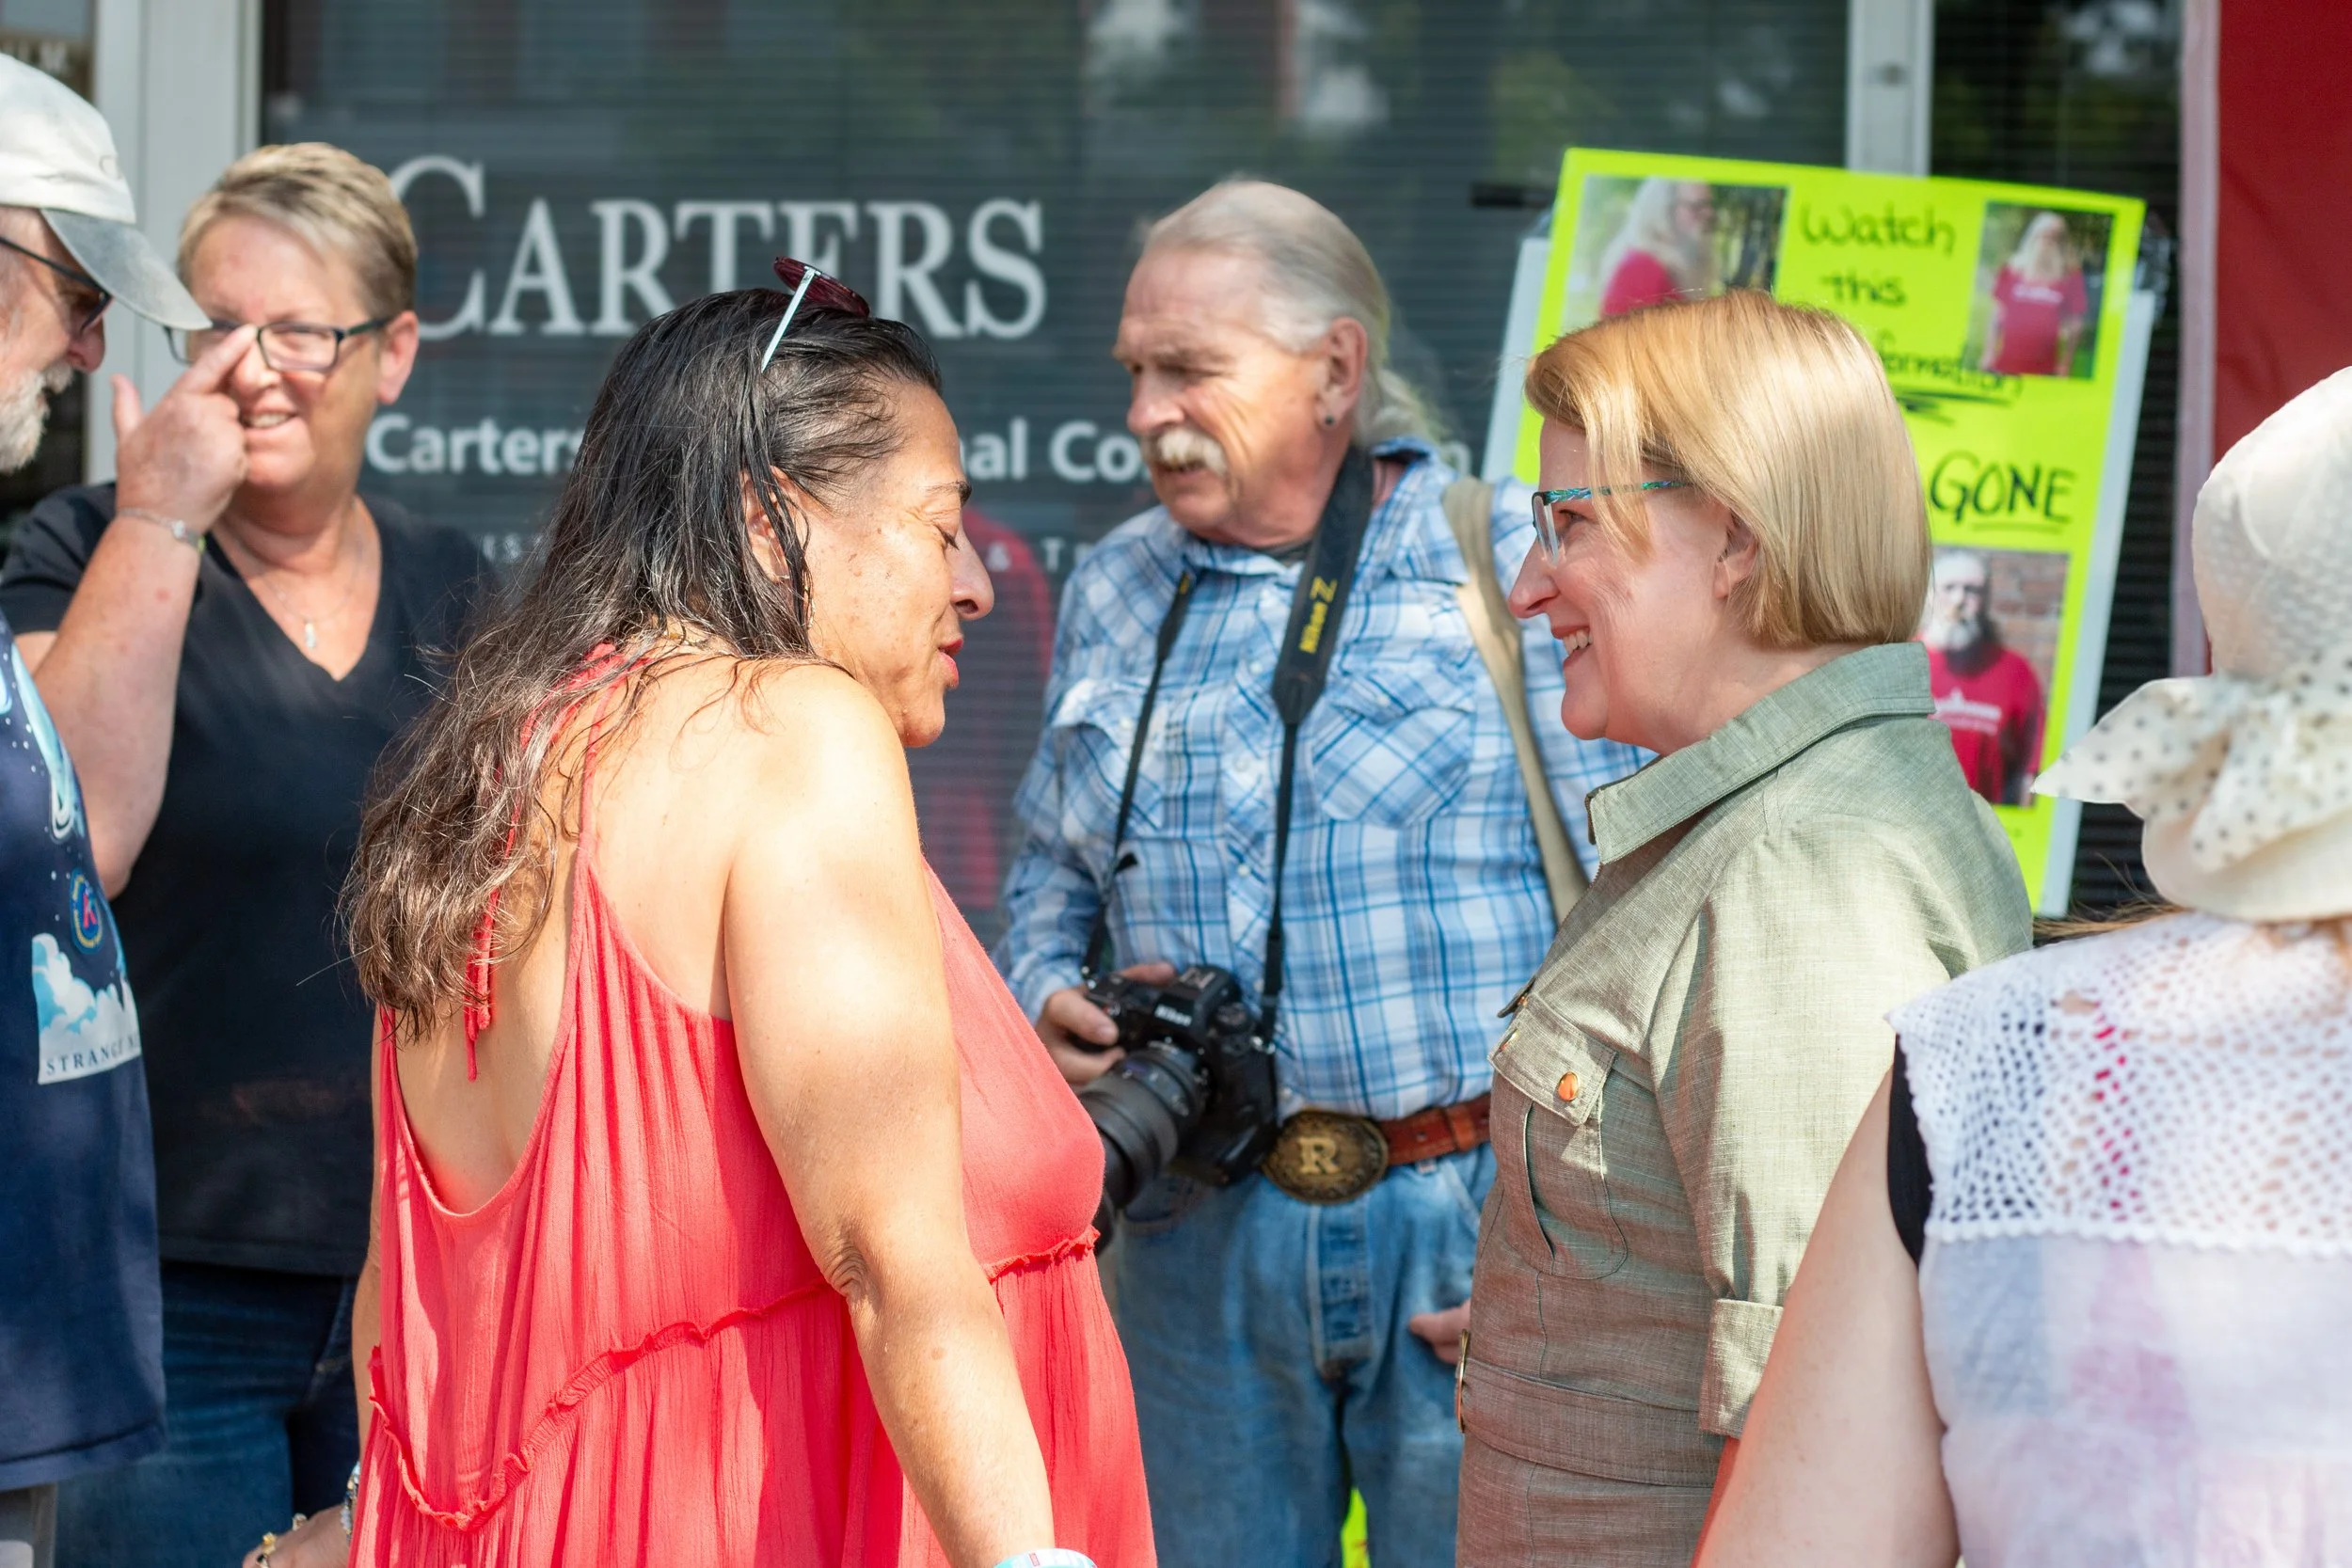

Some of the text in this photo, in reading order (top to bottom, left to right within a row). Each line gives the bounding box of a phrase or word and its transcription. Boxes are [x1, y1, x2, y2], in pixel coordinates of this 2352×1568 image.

[1799, 200, 1958, 259] Watch
[1049, 420, 1151, 483] Co
[1930, 450, 2078, 525] GONE
[1299, 1136, 1339, 1174] R
